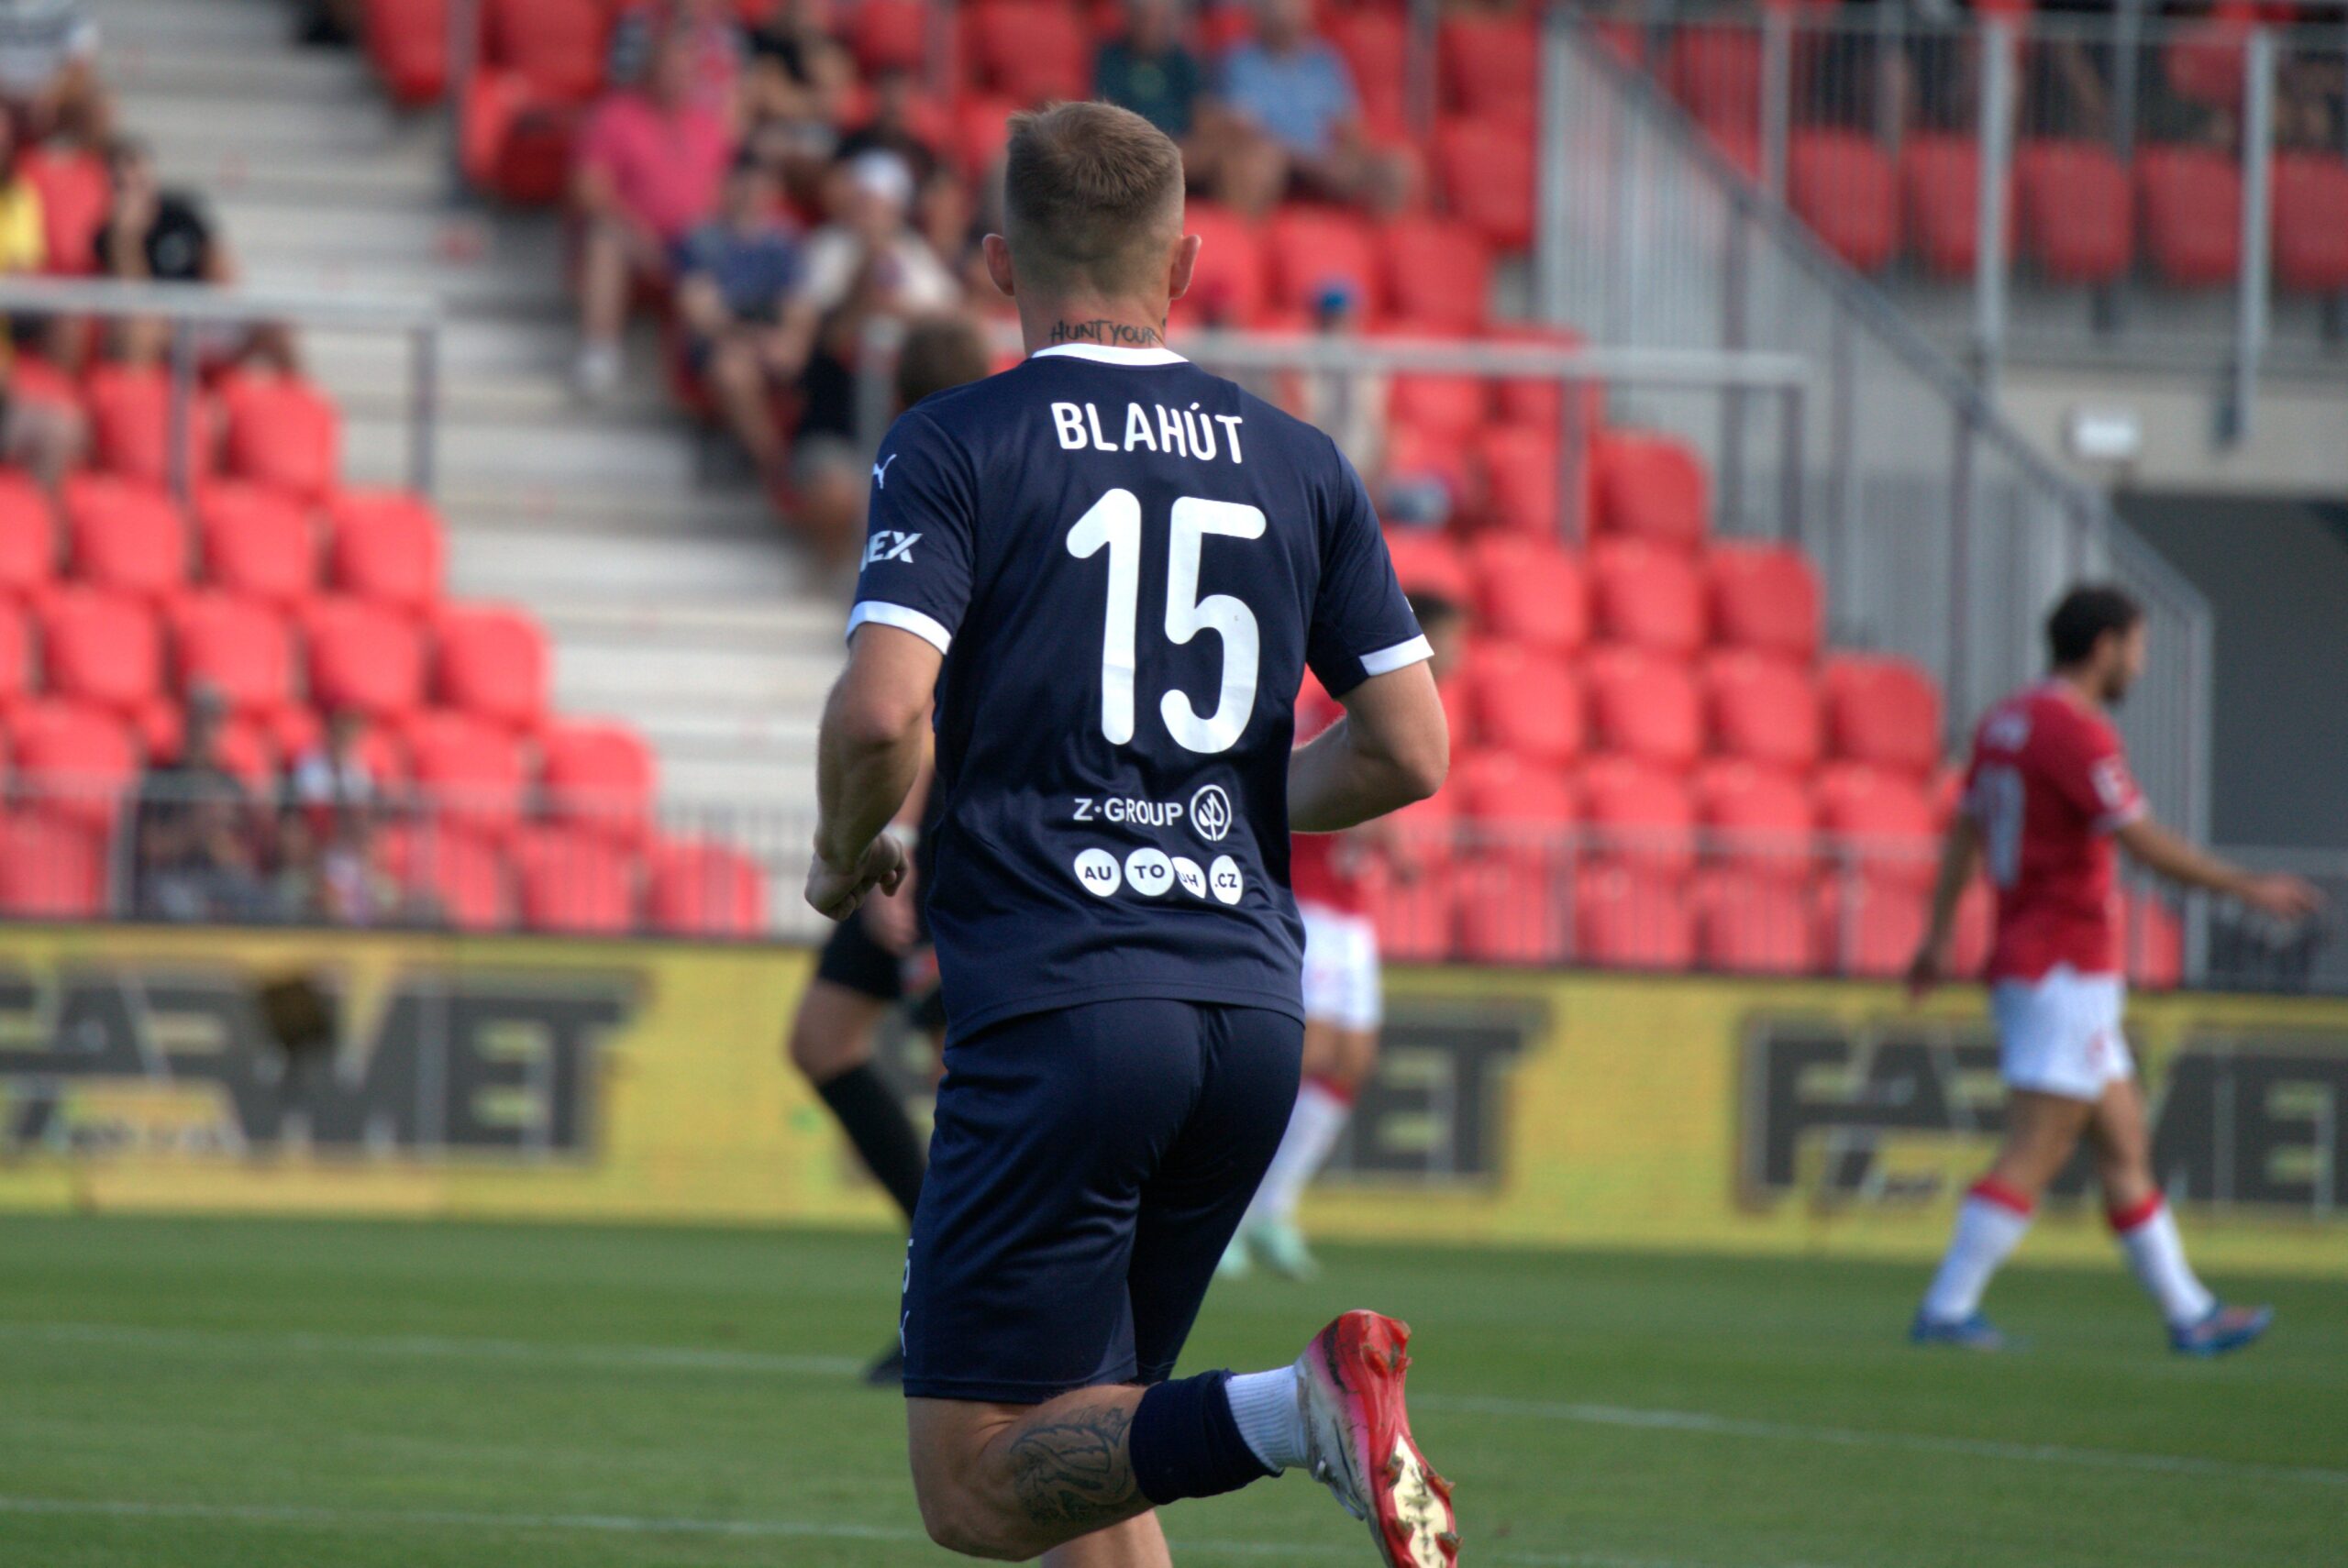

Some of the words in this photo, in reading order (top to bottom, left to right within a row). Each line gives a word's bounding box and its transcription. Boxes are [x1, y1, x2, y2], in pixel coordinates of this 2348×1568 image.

[1050, 318, 1113, 344] HUNT
[1108, 324, 1156, 347] YOUR
[1050, 402, 1243, 464] BLAHÚT
[859, 530, 923, 572] EX
[1066, 488, 1267, 753] 15
